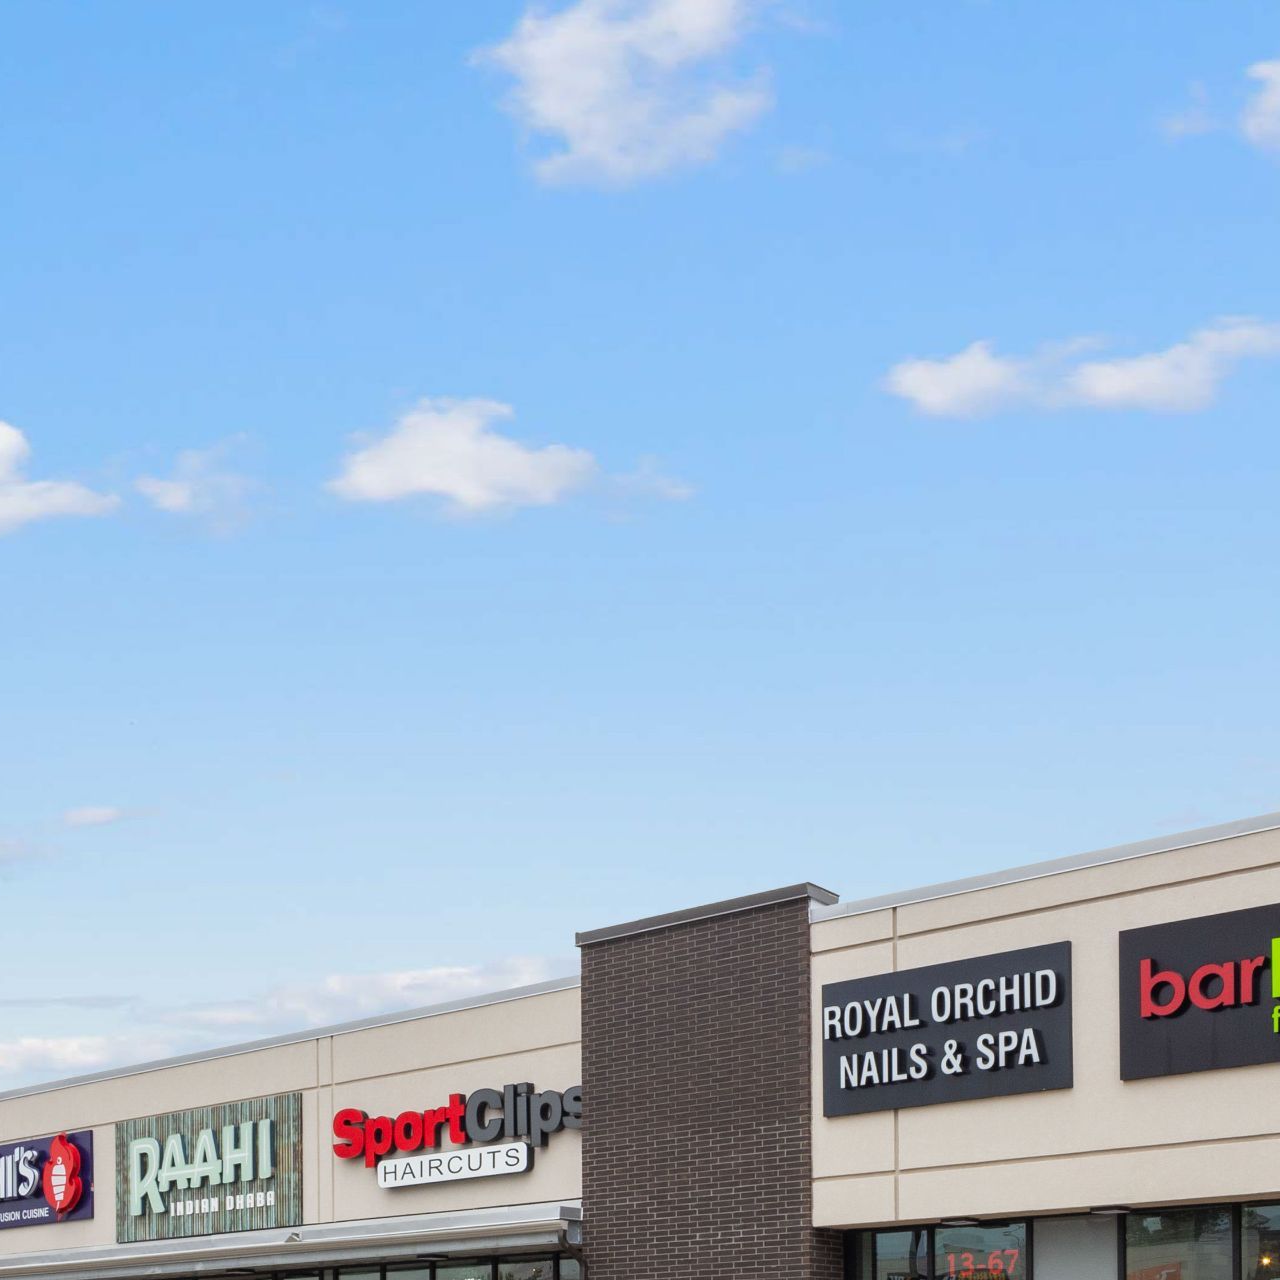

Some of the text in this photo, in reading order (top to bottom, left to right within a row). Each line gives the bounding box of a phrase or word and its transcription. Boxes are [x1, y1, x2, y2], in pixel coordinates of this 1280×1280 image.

[823, 968, 1058, 1041] ROYAL ORCHID
[838, 1026, 1042, 1091] NAILS & SPA
[129, 1118, 273, 1216] RAAHI
[382, 1147, 521, 1183] HAIRCUTS
[22, 1207, 50, 1220] CUISINE
[170, 1190, 276, 1217] INDIAN DHABA
